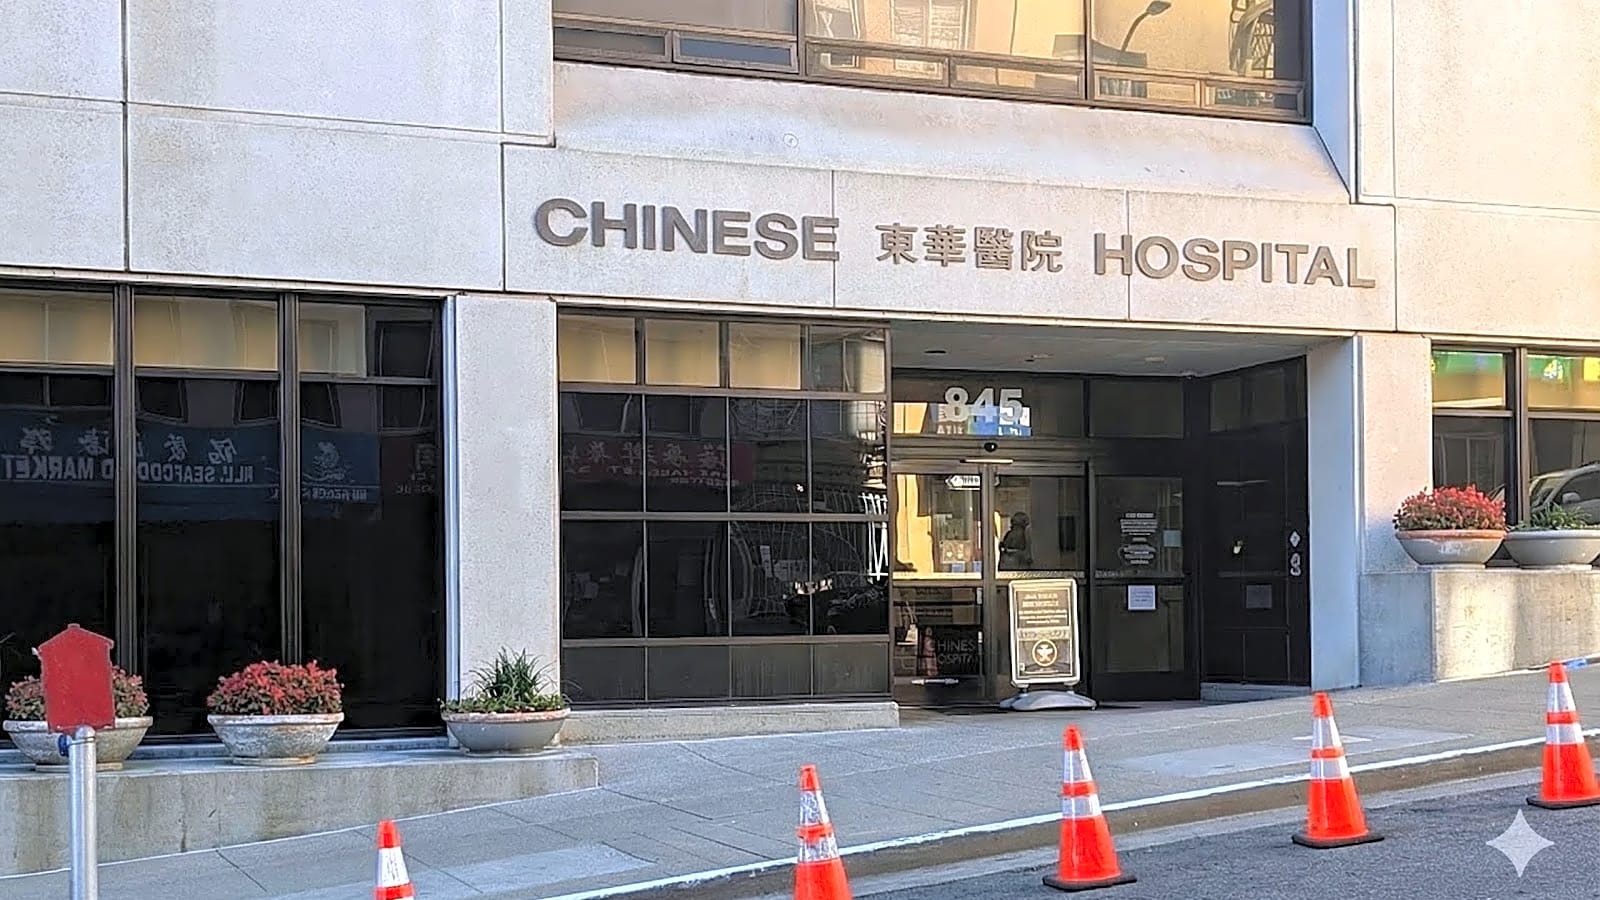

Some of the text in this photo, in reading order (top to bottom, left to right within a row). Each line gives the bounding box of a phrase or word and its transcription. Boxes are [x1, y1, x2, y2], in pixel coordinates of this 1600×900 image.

[534, 197, 840, 261] CHINESE
[875, 222, 1063, 272] 東華醫院
[1093, 232, 1377, 288] HOSPITAL
[944, 386, 1023, 422] 845
[925, 638, 976, 652] CHINES
